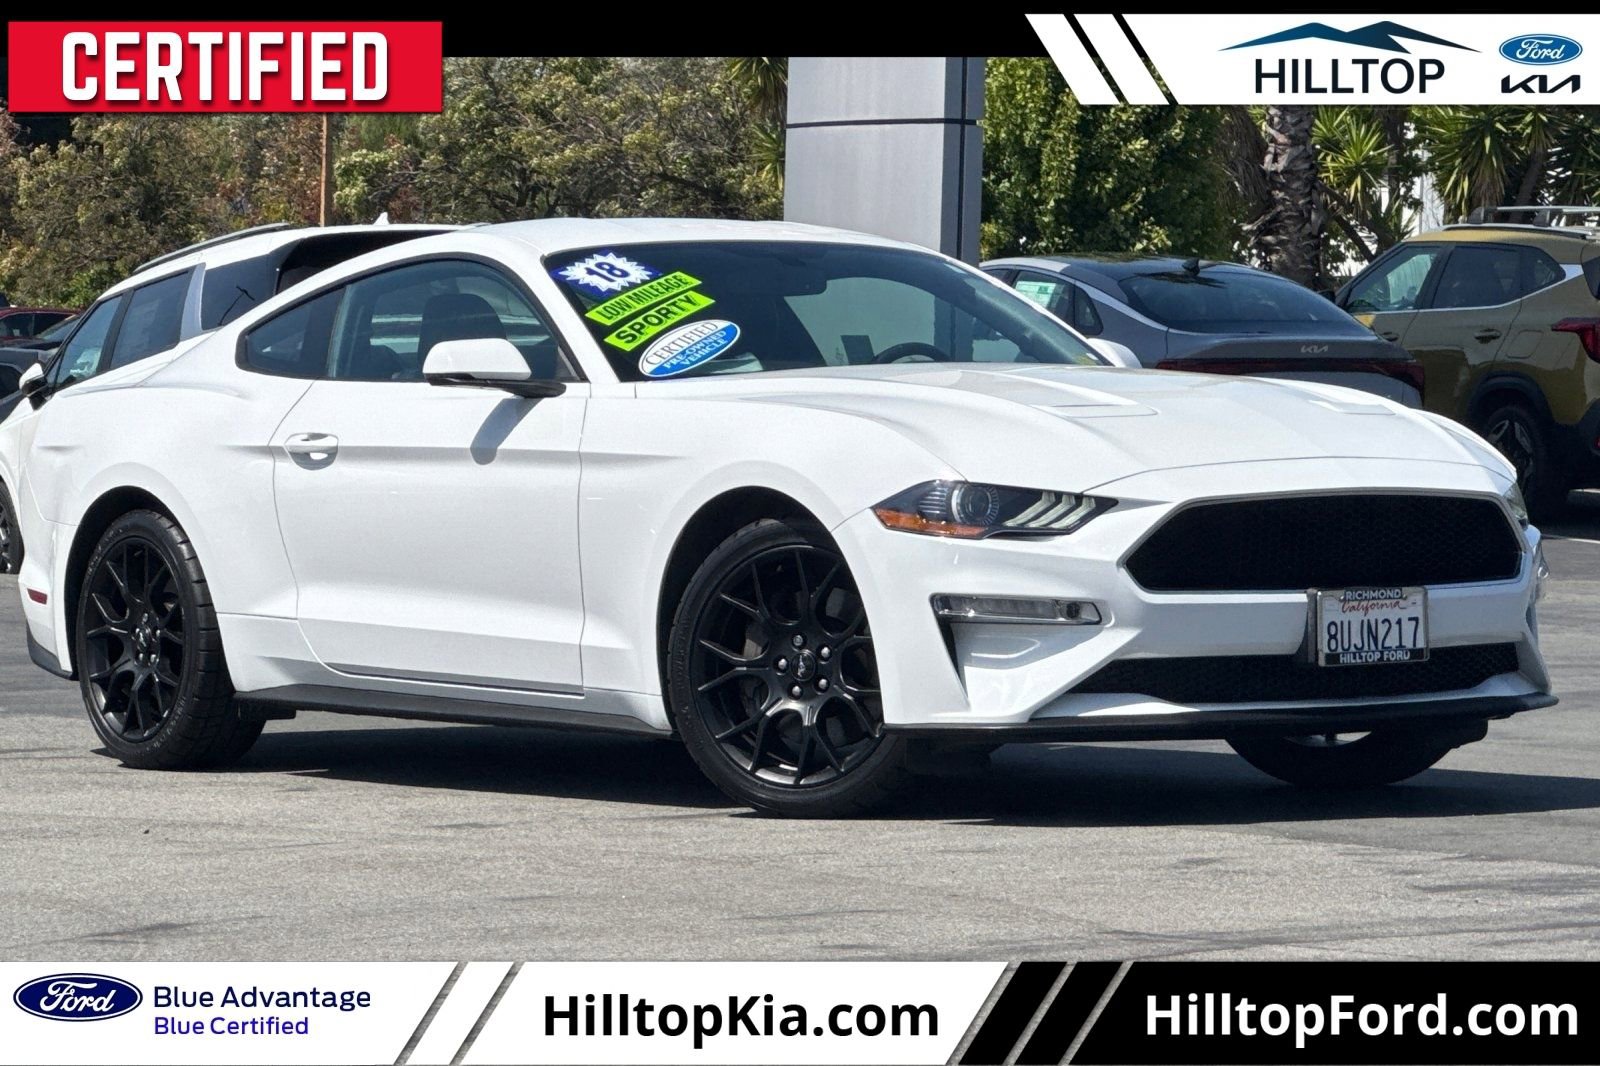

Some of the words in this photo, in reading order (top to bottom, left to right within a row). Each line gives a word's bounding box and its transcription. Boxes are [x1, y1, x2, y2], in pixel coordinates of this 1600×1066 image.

[585, 261, 630, 283] 18
[596, 296, 633, 321] LOW
[631, 274, 688, 307] MILEAGE
[615, 294, 699, 344] SPORTY
[645, 321, 719, 366] CERTIFIED
[663, 330, 727, 370] PRE-OWNED
[680, 338, 727, 367] VEHICLE
[1341, 600, 1407, 616] California
[1346, 589, 1401, 600] RICHMOND
[1327, 617, 1419, 652] 8UJN217
[1340, 651, 1381, 663] HILLTOP
[1383, 650, 1410, 661] FORD
